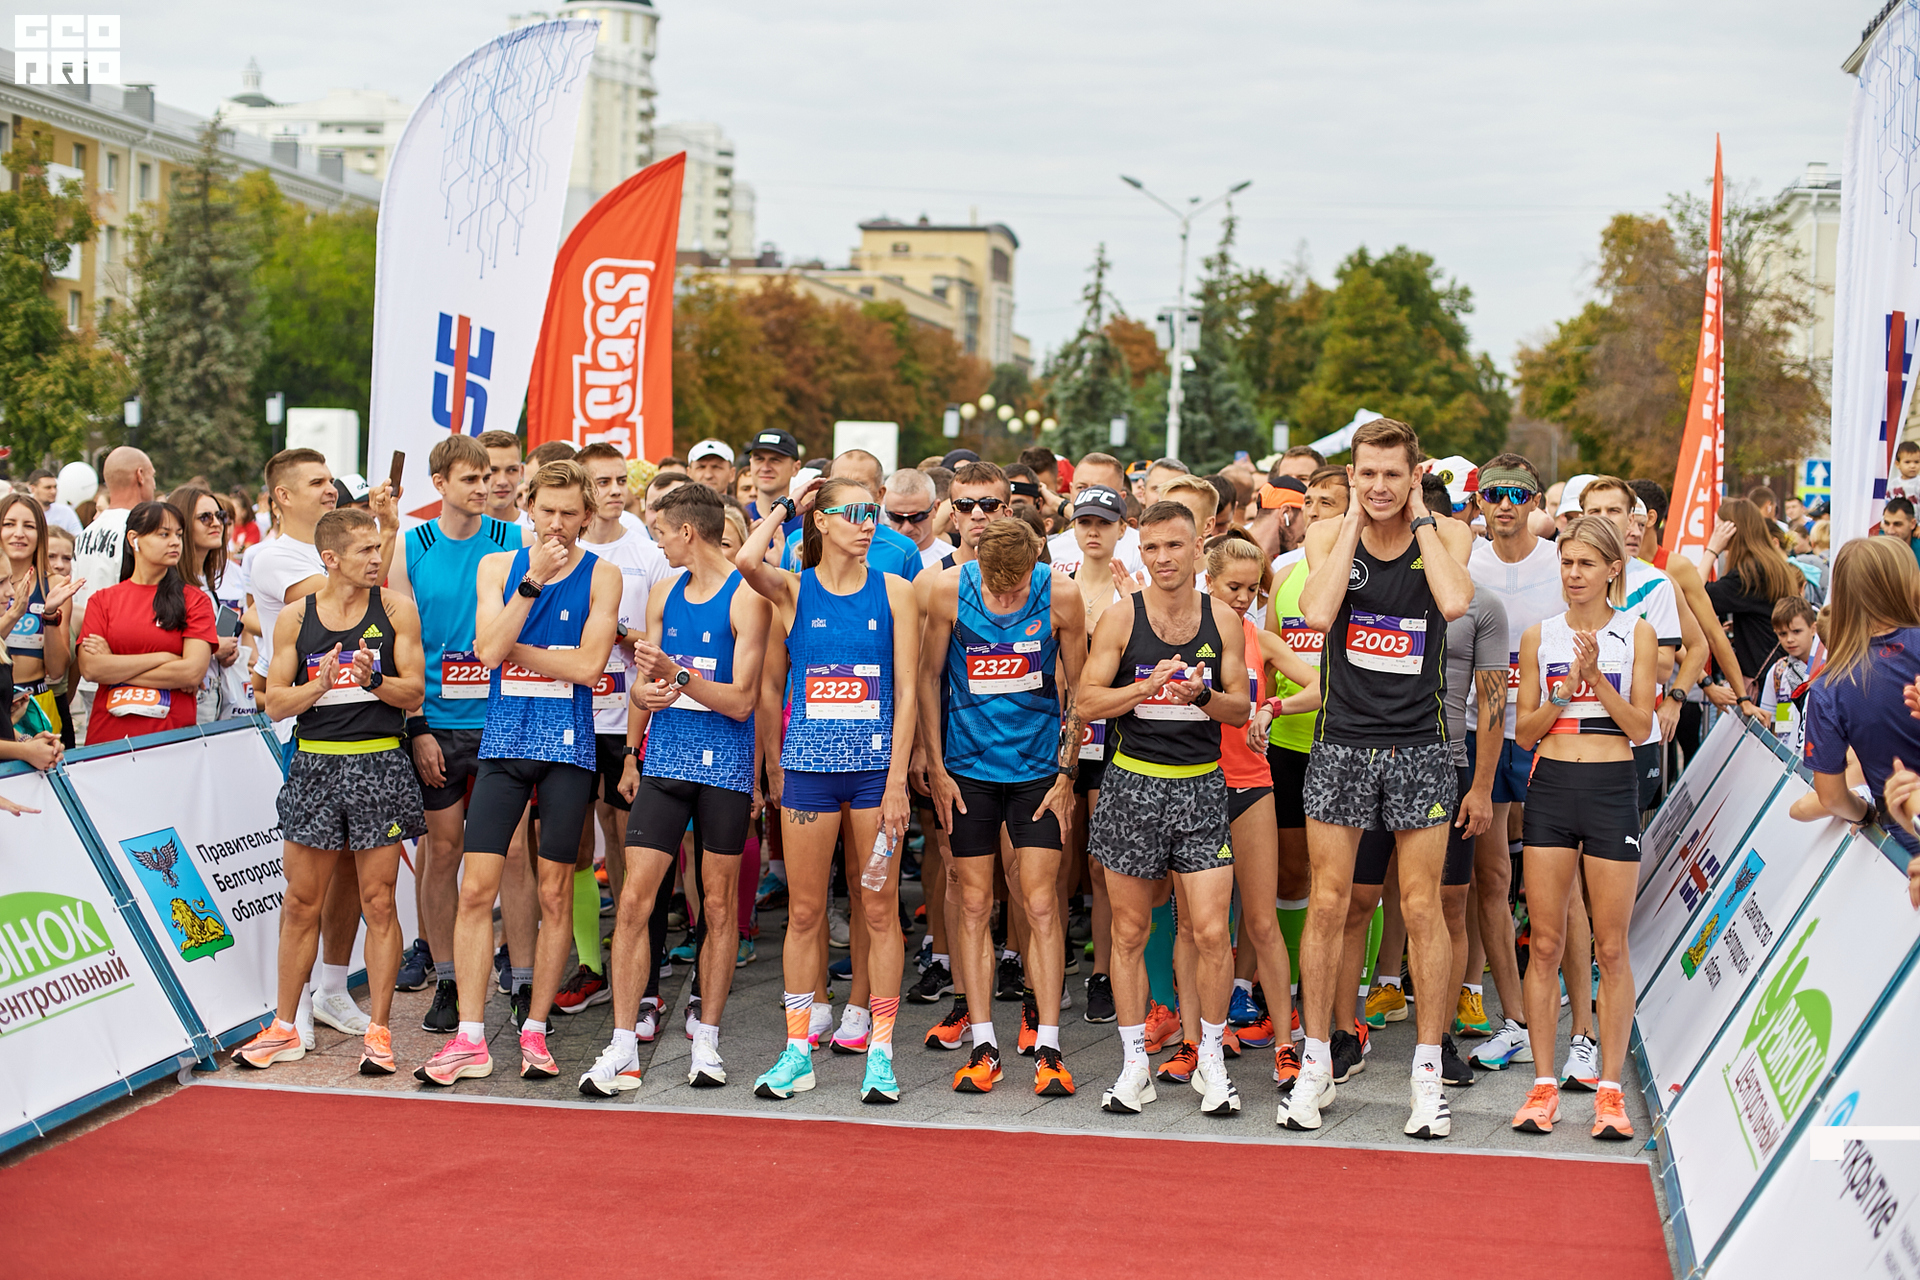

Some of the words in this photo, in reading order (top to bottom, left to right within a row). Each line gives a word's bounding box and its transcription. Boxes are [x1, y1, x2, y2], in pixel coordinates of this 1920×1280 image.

[1074, 490, 1116, 506] UFC
[1286, 631, 1324, 650] 2078
[1351, 630, 1410, 654] 2003
[446, 665, 490, 682] 2228
[972, 658, 1023, 676] 2327
[111, 688, 156, 704] 5433
[810, 681, 862, 699] 2323
[0, 949, 131, 1027] ентральный
[1761, 996, 1826, 1116] РЫНОК
[1732, 1050, 1786, 1161] Центральный
